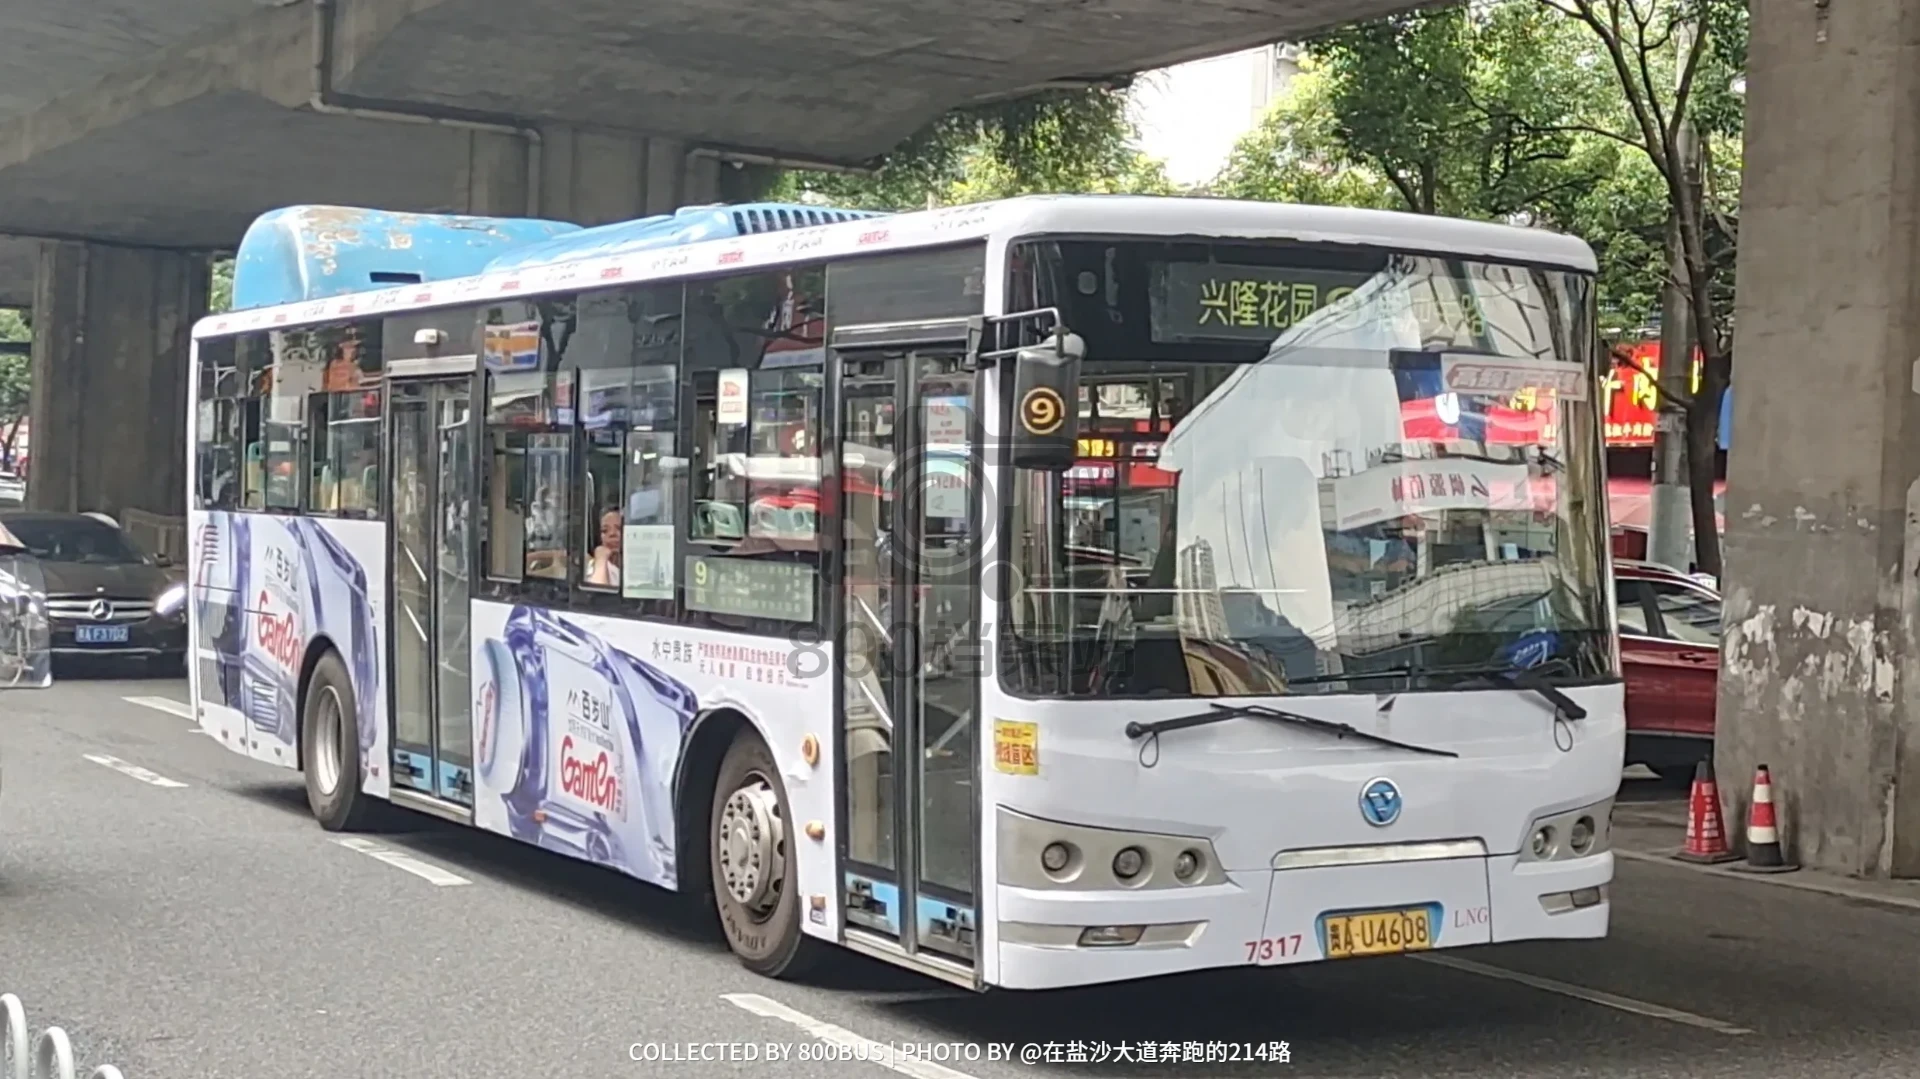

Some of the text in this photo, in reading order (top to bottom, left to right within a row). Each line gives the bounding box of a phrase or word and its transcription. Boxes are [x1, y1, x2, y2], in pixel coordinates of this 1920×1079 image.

[1199, 278, 1318, 329] 兴隆花园
[1030, 397, 1056, 424] 9
[695, 560, 707, 586] 9
[581, 689, 610, 731] 百岁山
[1454, 907, 1488, 928] LNG
[1245, 934, 1302, 962] 7317
